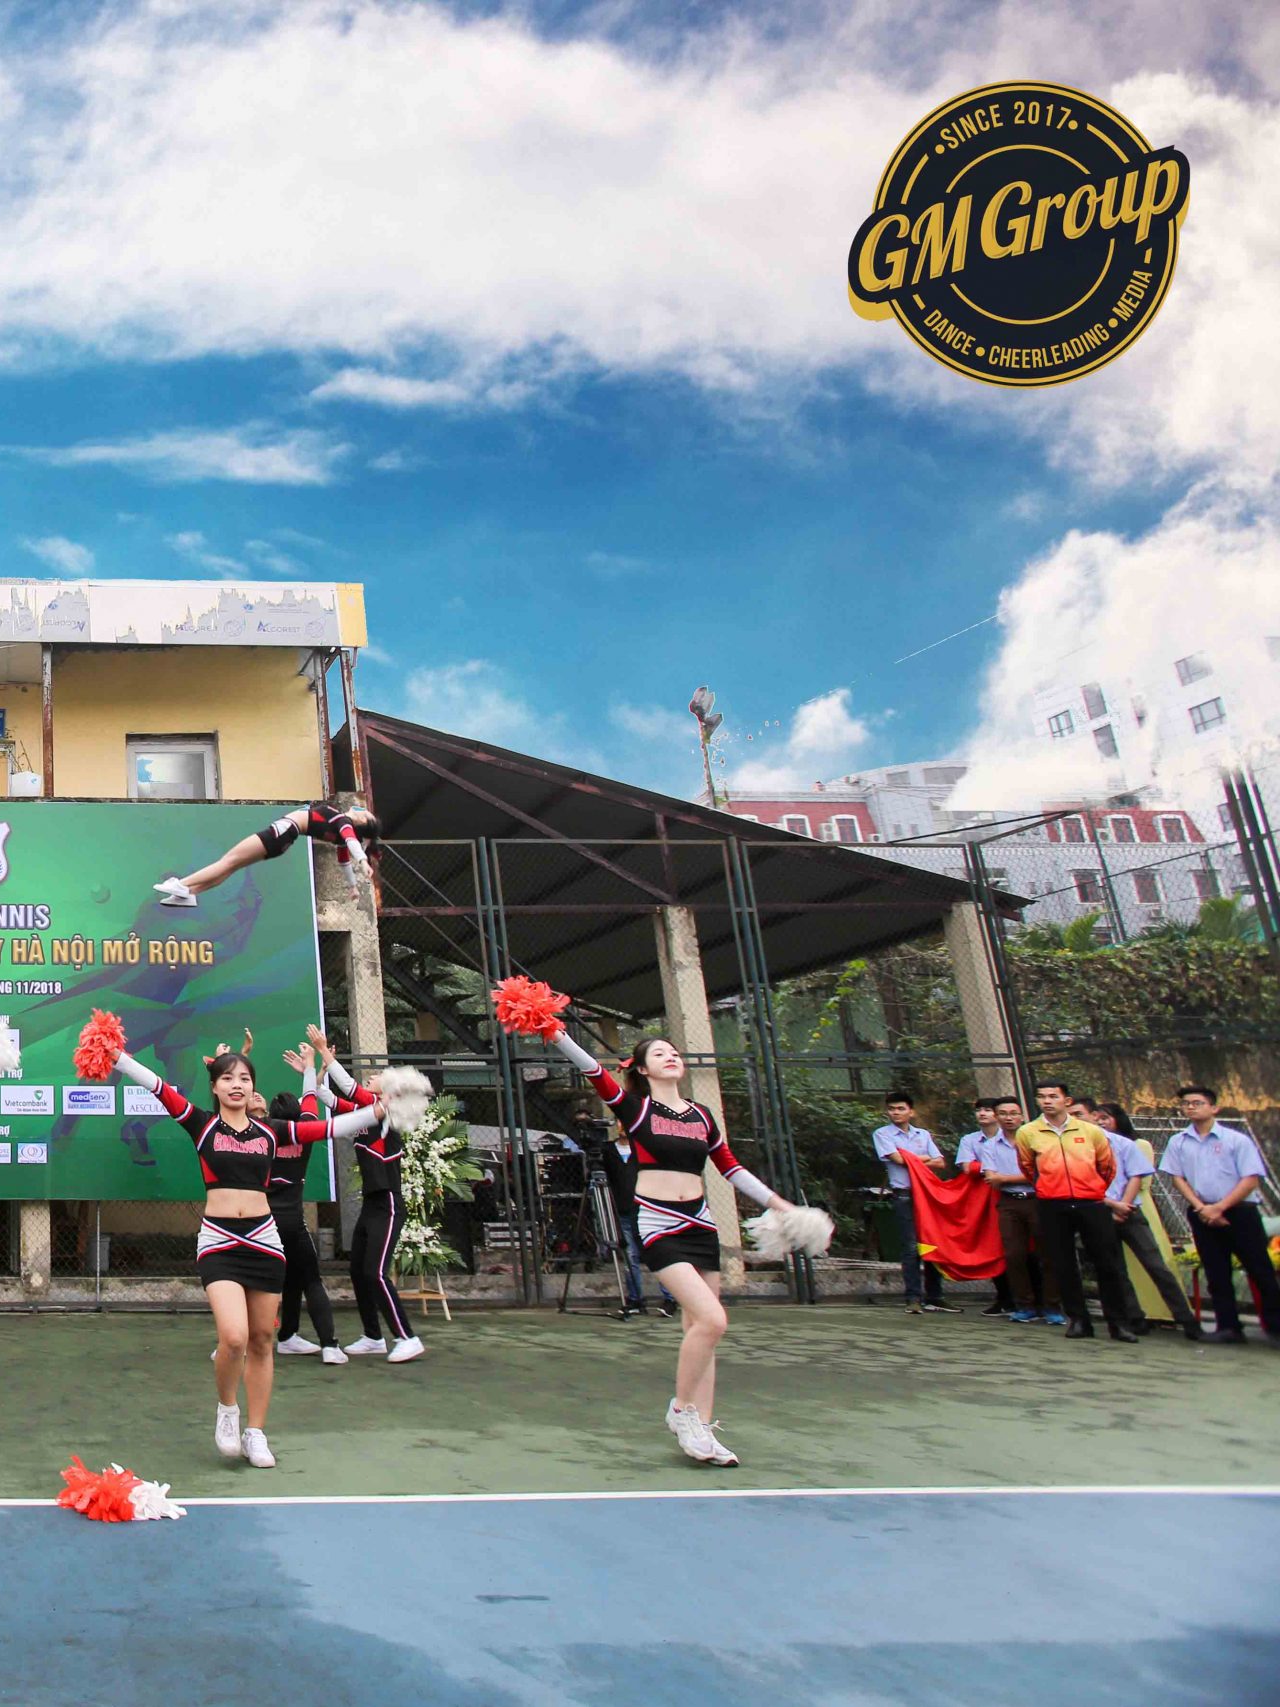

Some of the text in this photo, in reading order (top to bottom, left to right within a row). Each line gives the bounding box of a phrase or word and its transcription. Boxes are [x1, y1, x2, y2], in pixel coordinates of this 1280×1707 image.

[11, 934, 45, 964] HÀ
[51, 934, 94, 970] NỘI
[103, 932, 141, 965] MỞ
[149, 935, 214, 970] RỘNG
[15, 981, 62, 994] 11/2018
[4, 1099, 48, 1107] Vietcombank
[129, 1103, 166, 1113] AESCULA
